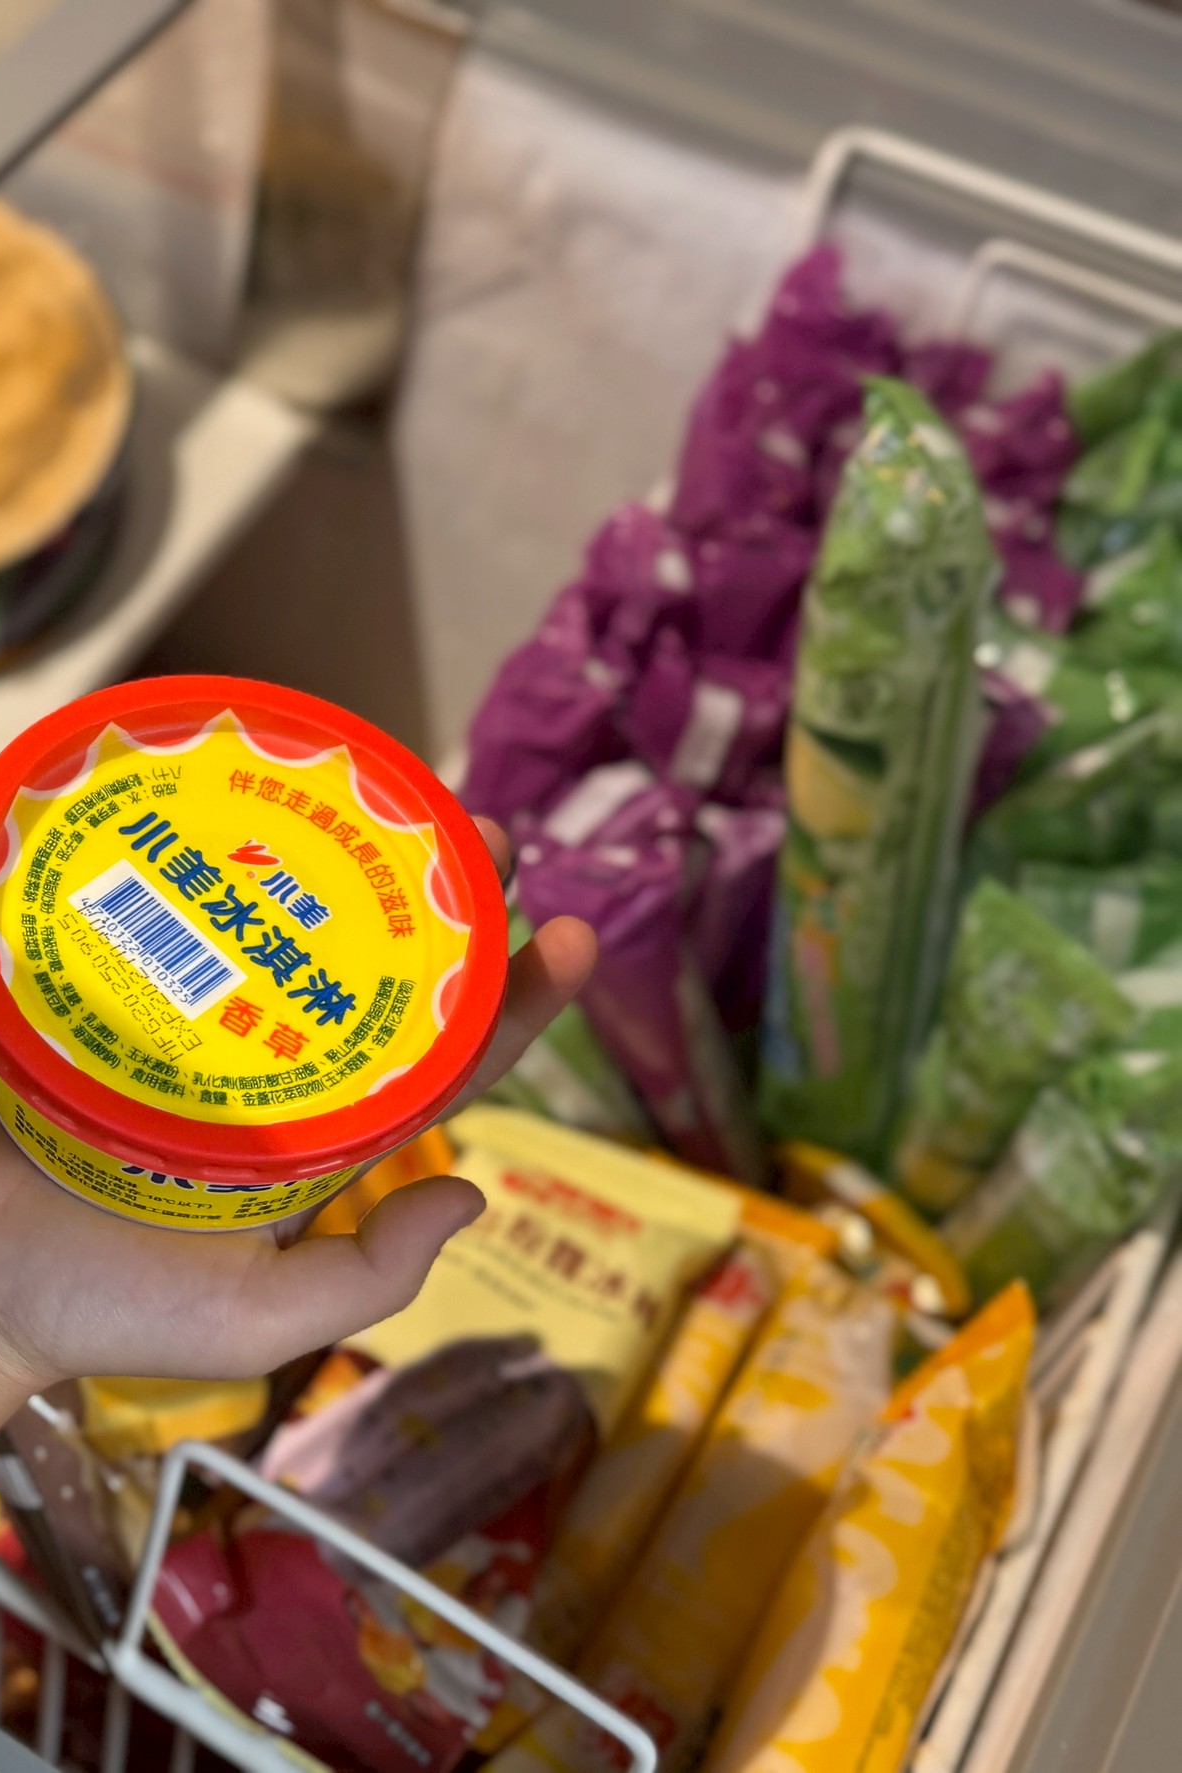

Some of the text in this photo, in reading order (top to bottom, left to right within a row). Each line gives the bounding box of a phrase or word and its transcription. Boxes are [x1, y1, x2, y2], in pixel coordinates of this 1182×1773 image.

[228, 769, 416, 939] 伴您走過成長的滋味
[259, 871, 330, 929] 小美
[118, 812, 356, 1026] 小美冰淇淋
[57, 913, 184, 1062] MFG20250905
[141, 956, 191, 1003] 010325
[219, 996, 310, 1062] 香草
